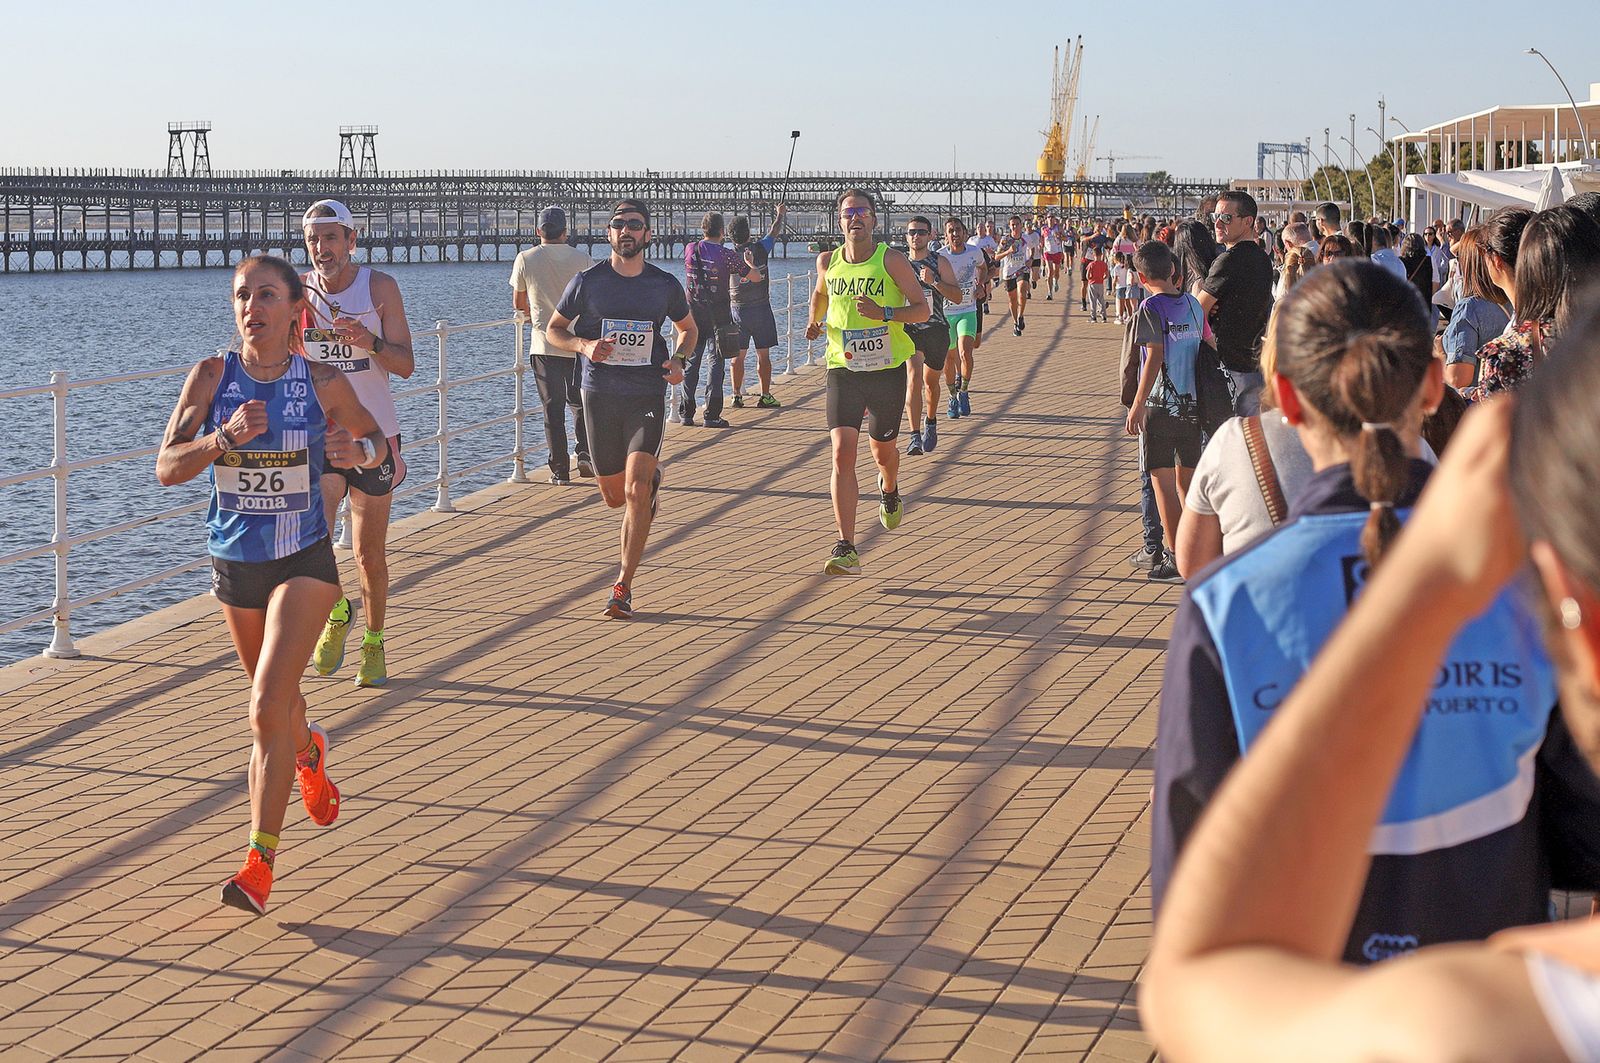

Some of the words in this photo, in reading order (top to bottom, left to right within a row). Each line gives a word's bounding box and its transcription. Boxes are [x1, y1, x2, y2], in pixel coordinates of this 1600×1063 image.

[827, 277, 884, 296] MUDARRA
[319, 344, 353, 359] 340
[851, 338, 884, 353] 1403
[327, 361, 355, 371] ma
[247, 452, 297, 460] RUNNING
[259, 460, 289, 468] LOOP
[238, 471, 285, 493] 526
